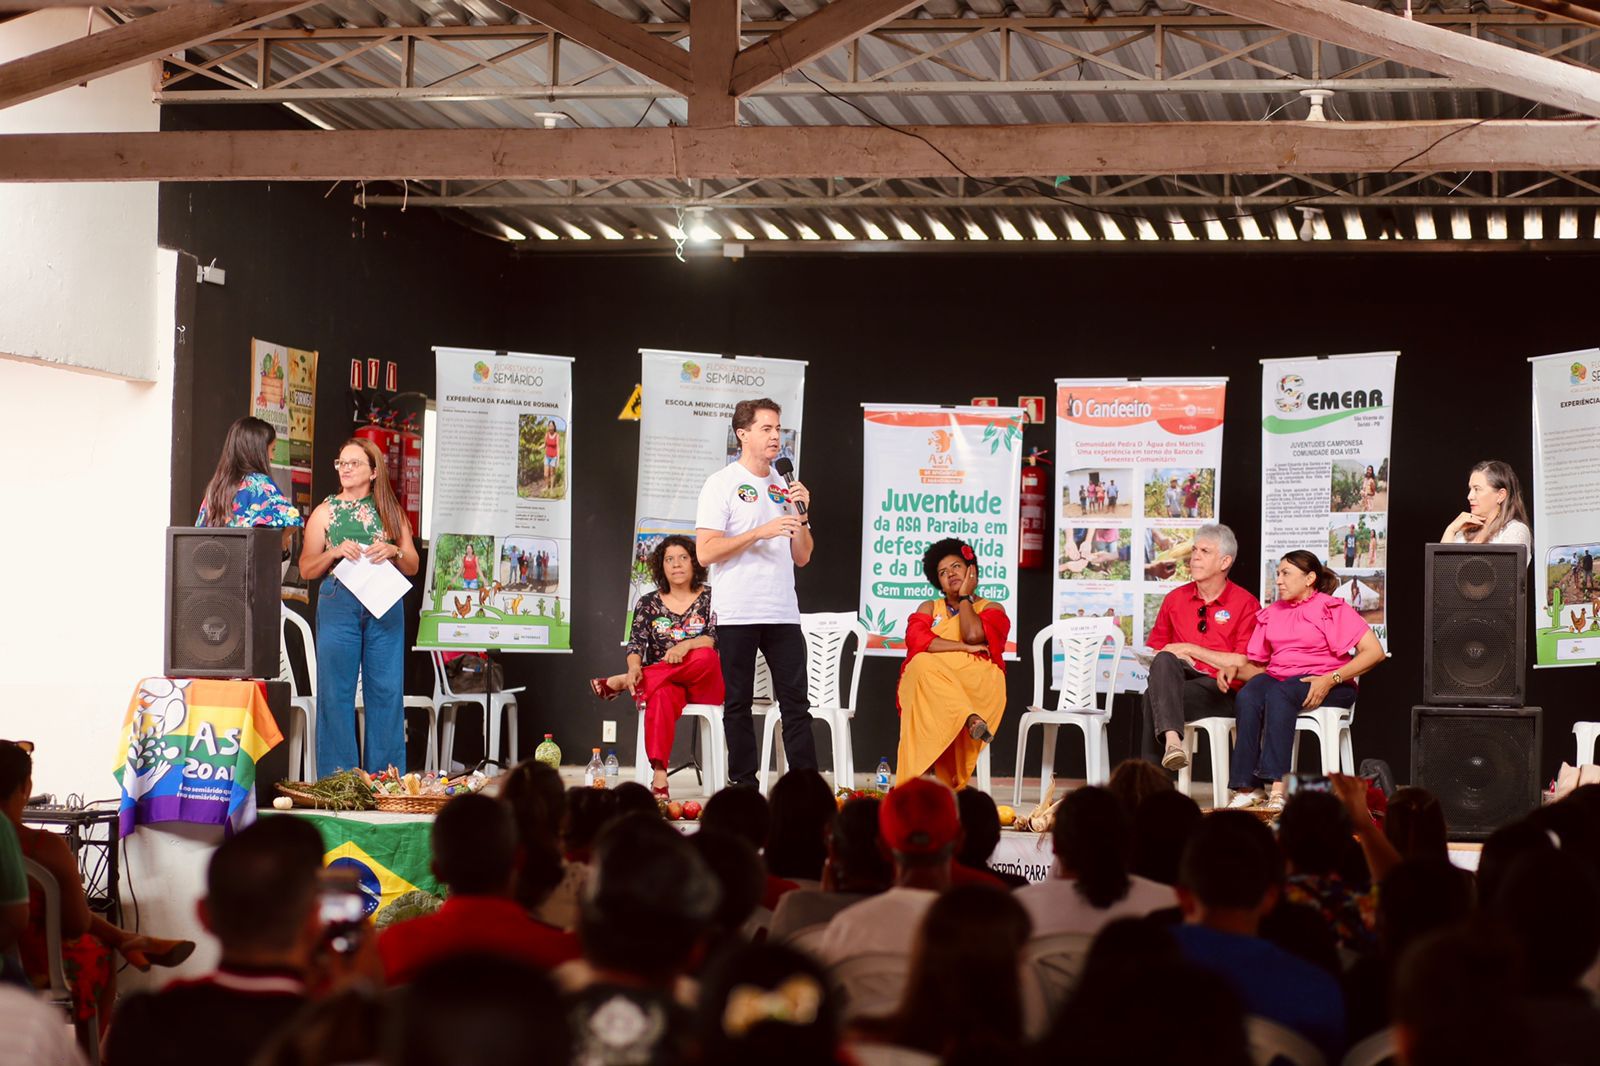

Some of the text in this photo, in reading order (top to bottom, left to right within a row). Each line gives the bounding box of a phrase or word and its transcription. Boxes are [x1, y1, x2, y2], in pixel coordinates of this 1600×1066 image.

[446, 395, 486, 404] EXPERIÊNCIA
[496, 398, 522, 406] FAMÍLIA
[665, 400, 735, 410] ESCOLA MUNICIPAL
[1072, 400, 1152, 418] O Candeeiro
[882, 488, 1002, 514] Juventude
[874, 516, 890, 532] da
[896, 516, 921, 532] ASA
[984, 522, 1008, 534] em
[968, 538, 1004, 557] Vida
[873, 562, 882, 576] e
[889, 559, 907, 576] da
[877, 584, 900, 596] Sem
[904, 585, 934, 597] medo
[978, 586, 1006, 599] feliz!
[190, 722, 240, 756] AS
[182, 757, 213, 779] 20
[1025, 865, 1050, 881] PARA
